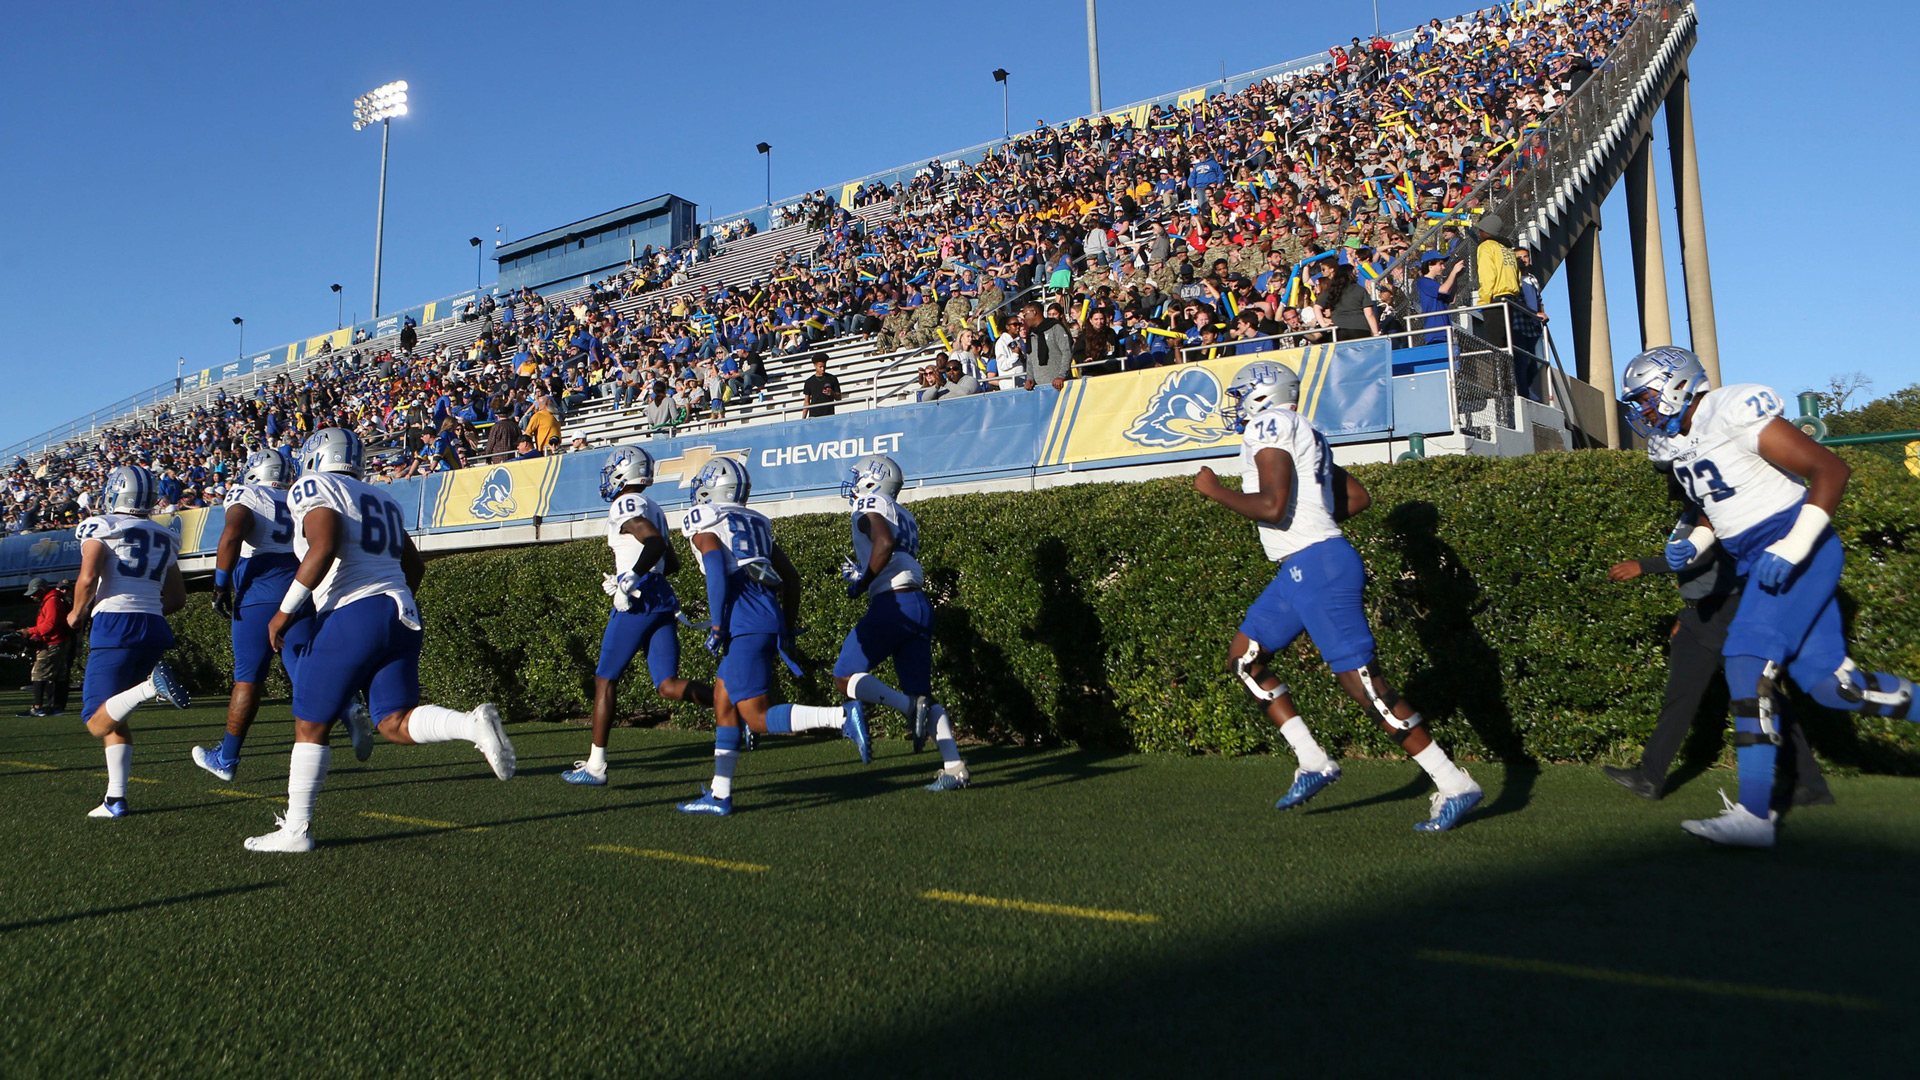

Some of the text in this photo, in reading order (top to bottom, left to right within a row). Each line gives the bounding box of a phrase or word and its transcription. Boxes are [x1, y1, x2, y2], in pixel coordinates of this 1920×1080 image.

[915, 159, 960, 178] ANOR
[376, 316, 398, 328] ANCHOR
[1250, 365, 1278, 386] HU
[1745, 391, 1777, 418] 73
[1254, 418, 1278, 440] 74
[761, 432, 904, 468] CHEVROLET
[292, 479, 318, 504] 60
[1674, 458, 1737, 504] 73
[226, 488, 245, 503] 57
[618, 498, 636, 515] 16
[857, 497, 876, 511] 82
[360, 493, 405, 560] 60
[683, 508, 701, 531] 80
[78, 523, 99, 539] 37
[727, 512, 772, 559] 80
[117, 527, 171, 583] 37
